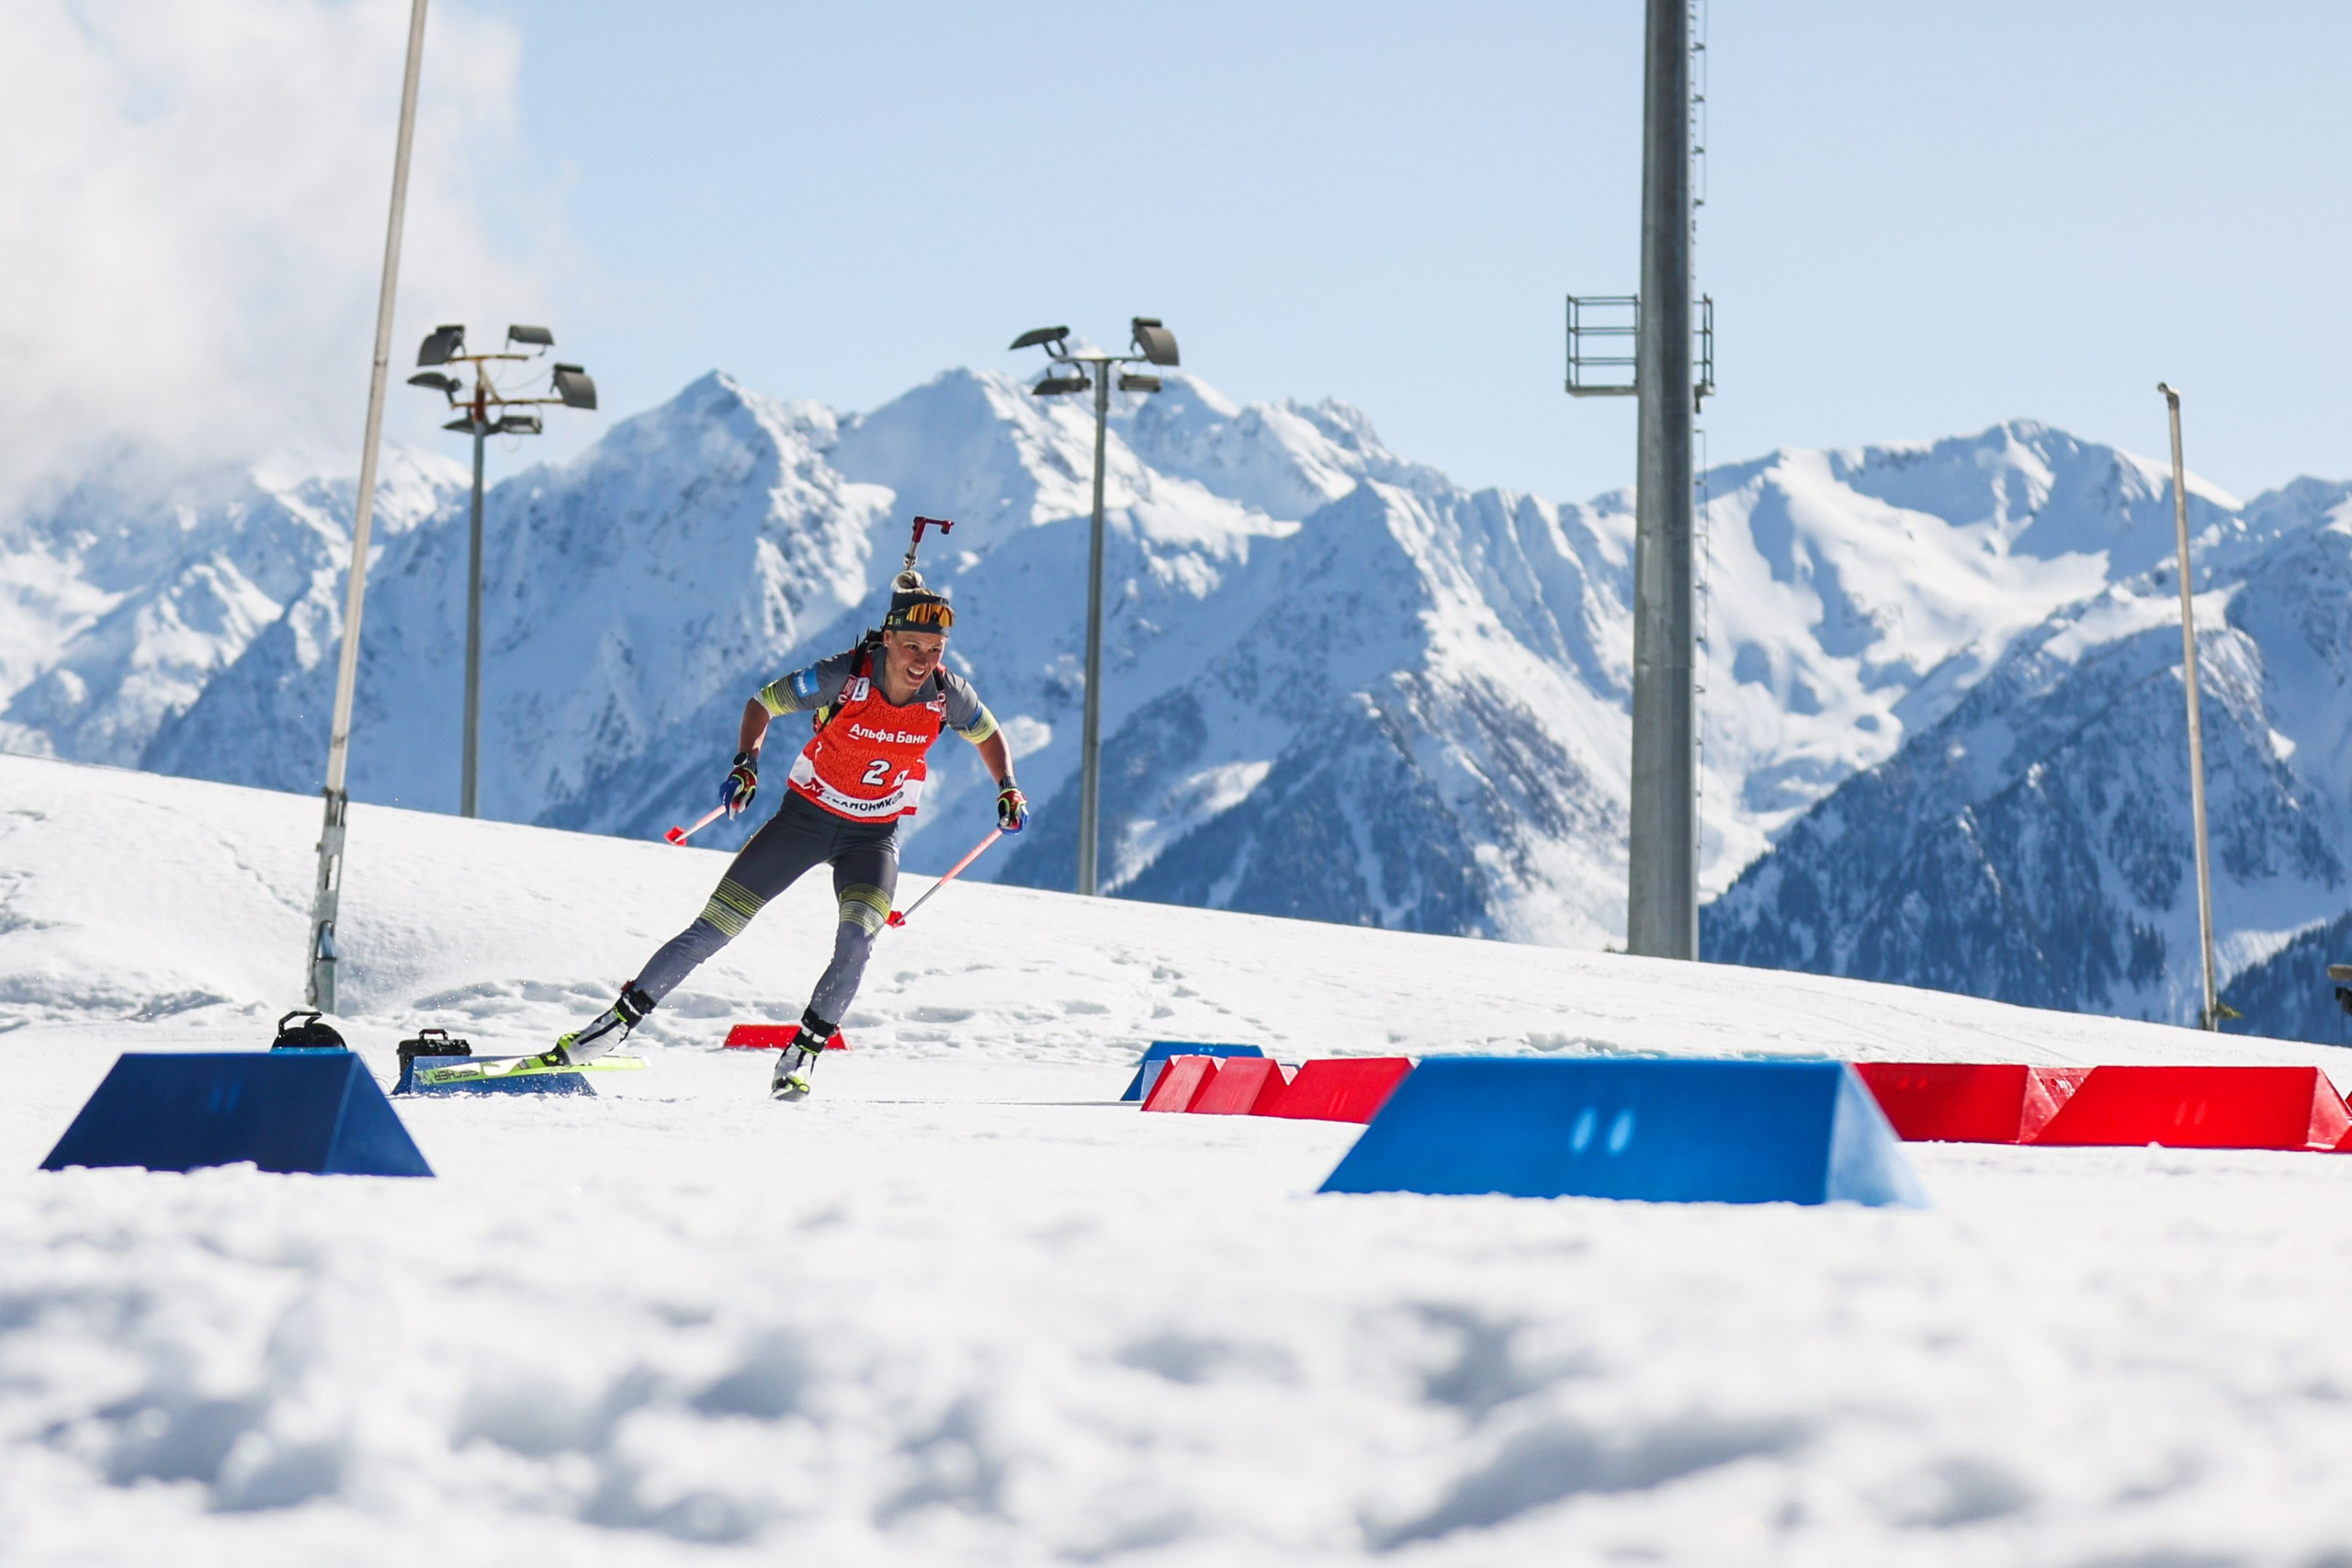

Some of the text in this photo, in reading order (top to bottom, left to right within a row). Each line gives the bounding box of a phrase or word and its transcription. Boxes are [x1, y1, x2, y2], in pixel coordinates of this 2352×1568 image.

[848, 723, 929, 744] Альфа Банк
[860, 759, 892, 786] 2
